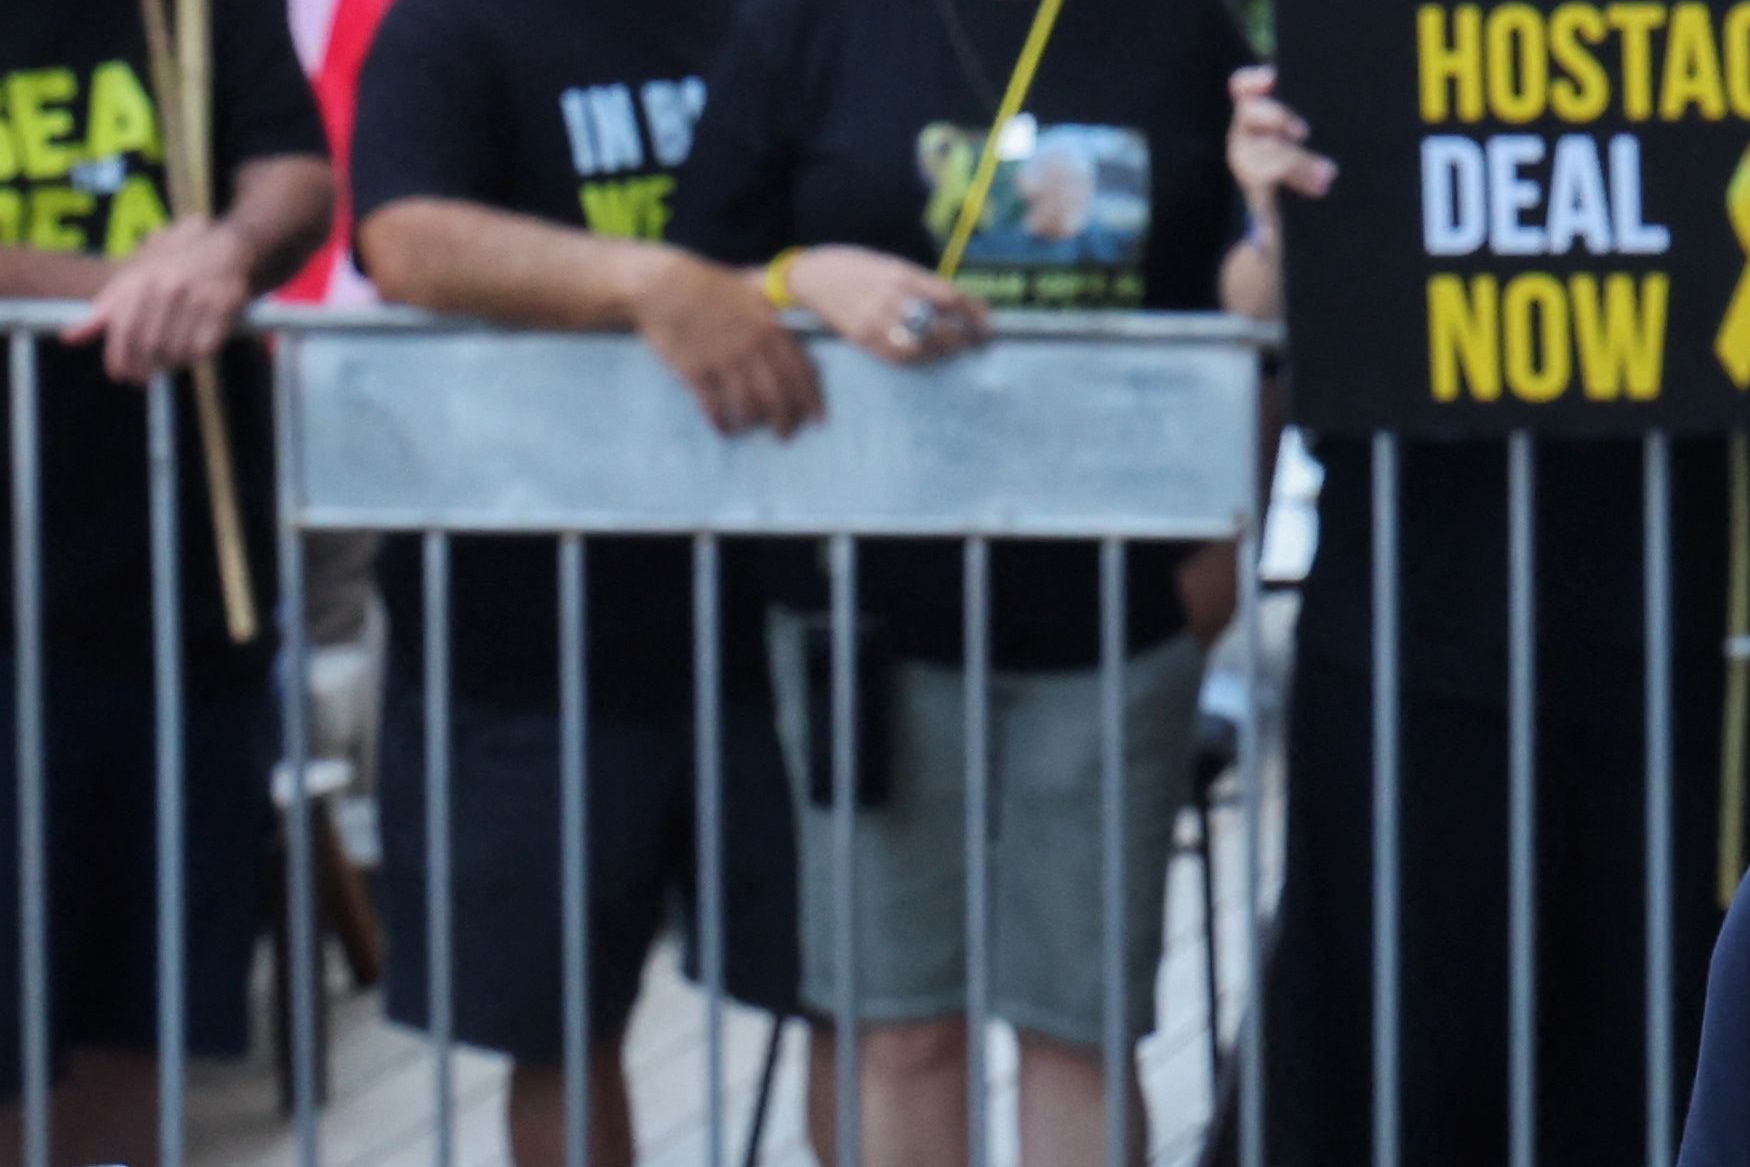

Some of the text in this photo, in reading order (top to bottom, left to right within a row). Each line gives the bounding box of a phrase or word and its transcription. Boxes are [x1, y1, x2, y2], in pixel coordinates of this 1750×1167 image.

[558, 82, 645, 176] IN
[1420, 132, 1671, 258] DEAL
[1426, 270, 1670, 402] NOW
